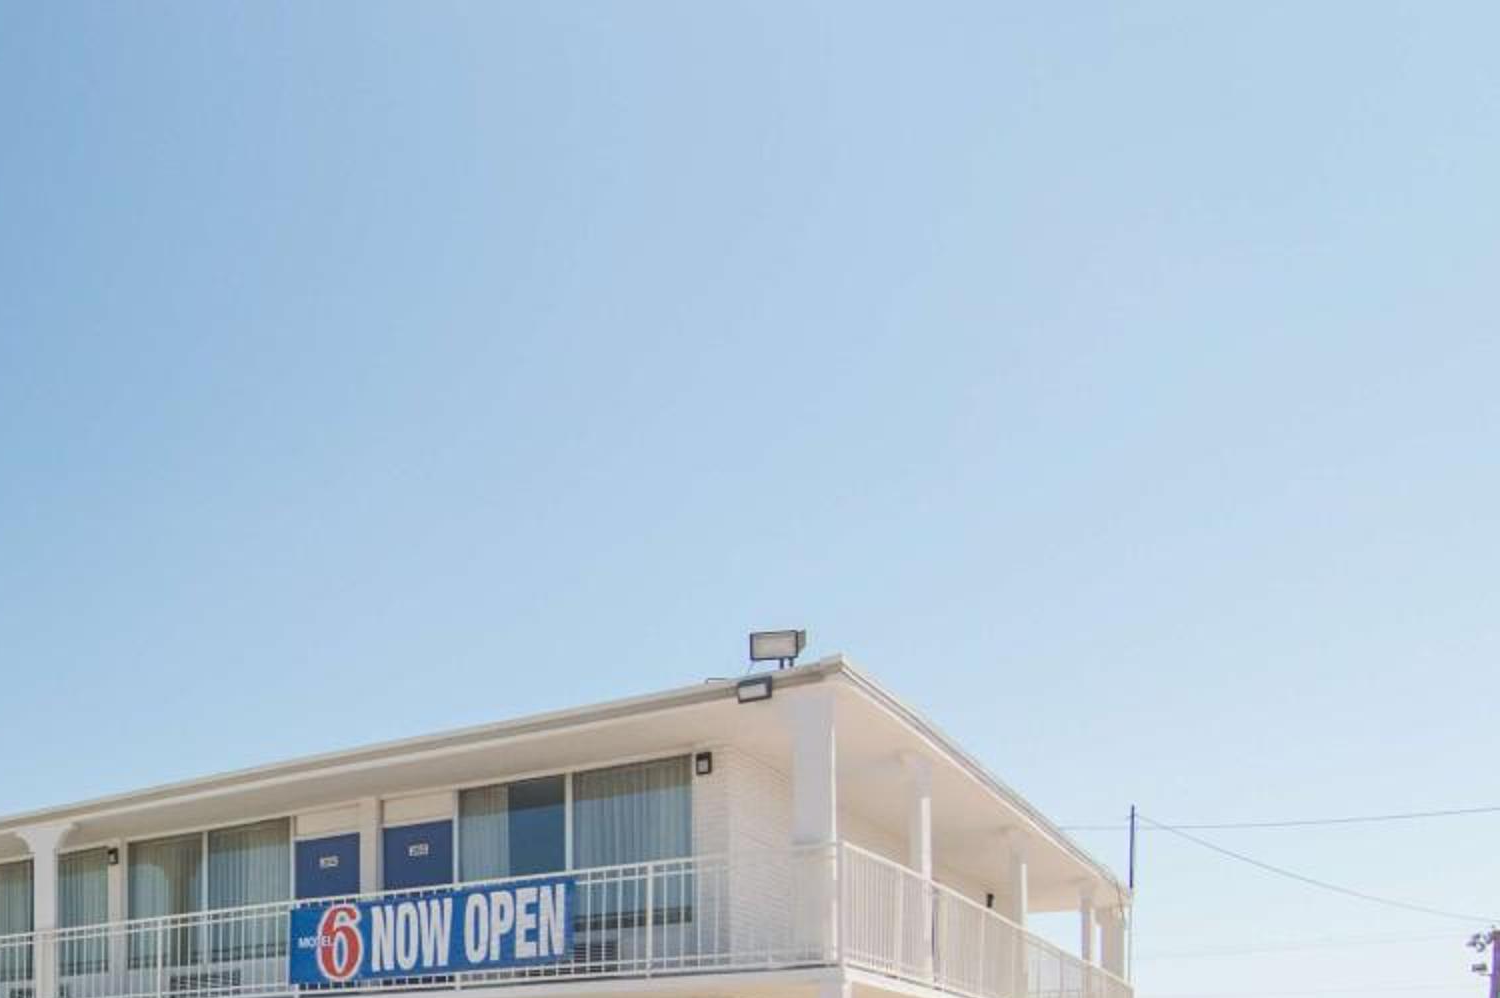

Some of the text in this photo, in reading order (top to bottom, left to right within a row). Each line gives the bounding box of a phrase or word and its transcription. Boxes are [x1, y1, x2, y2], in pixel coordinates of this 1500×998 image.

[298, 883, 565, 982] MOTEL 6 NOW OPEN
